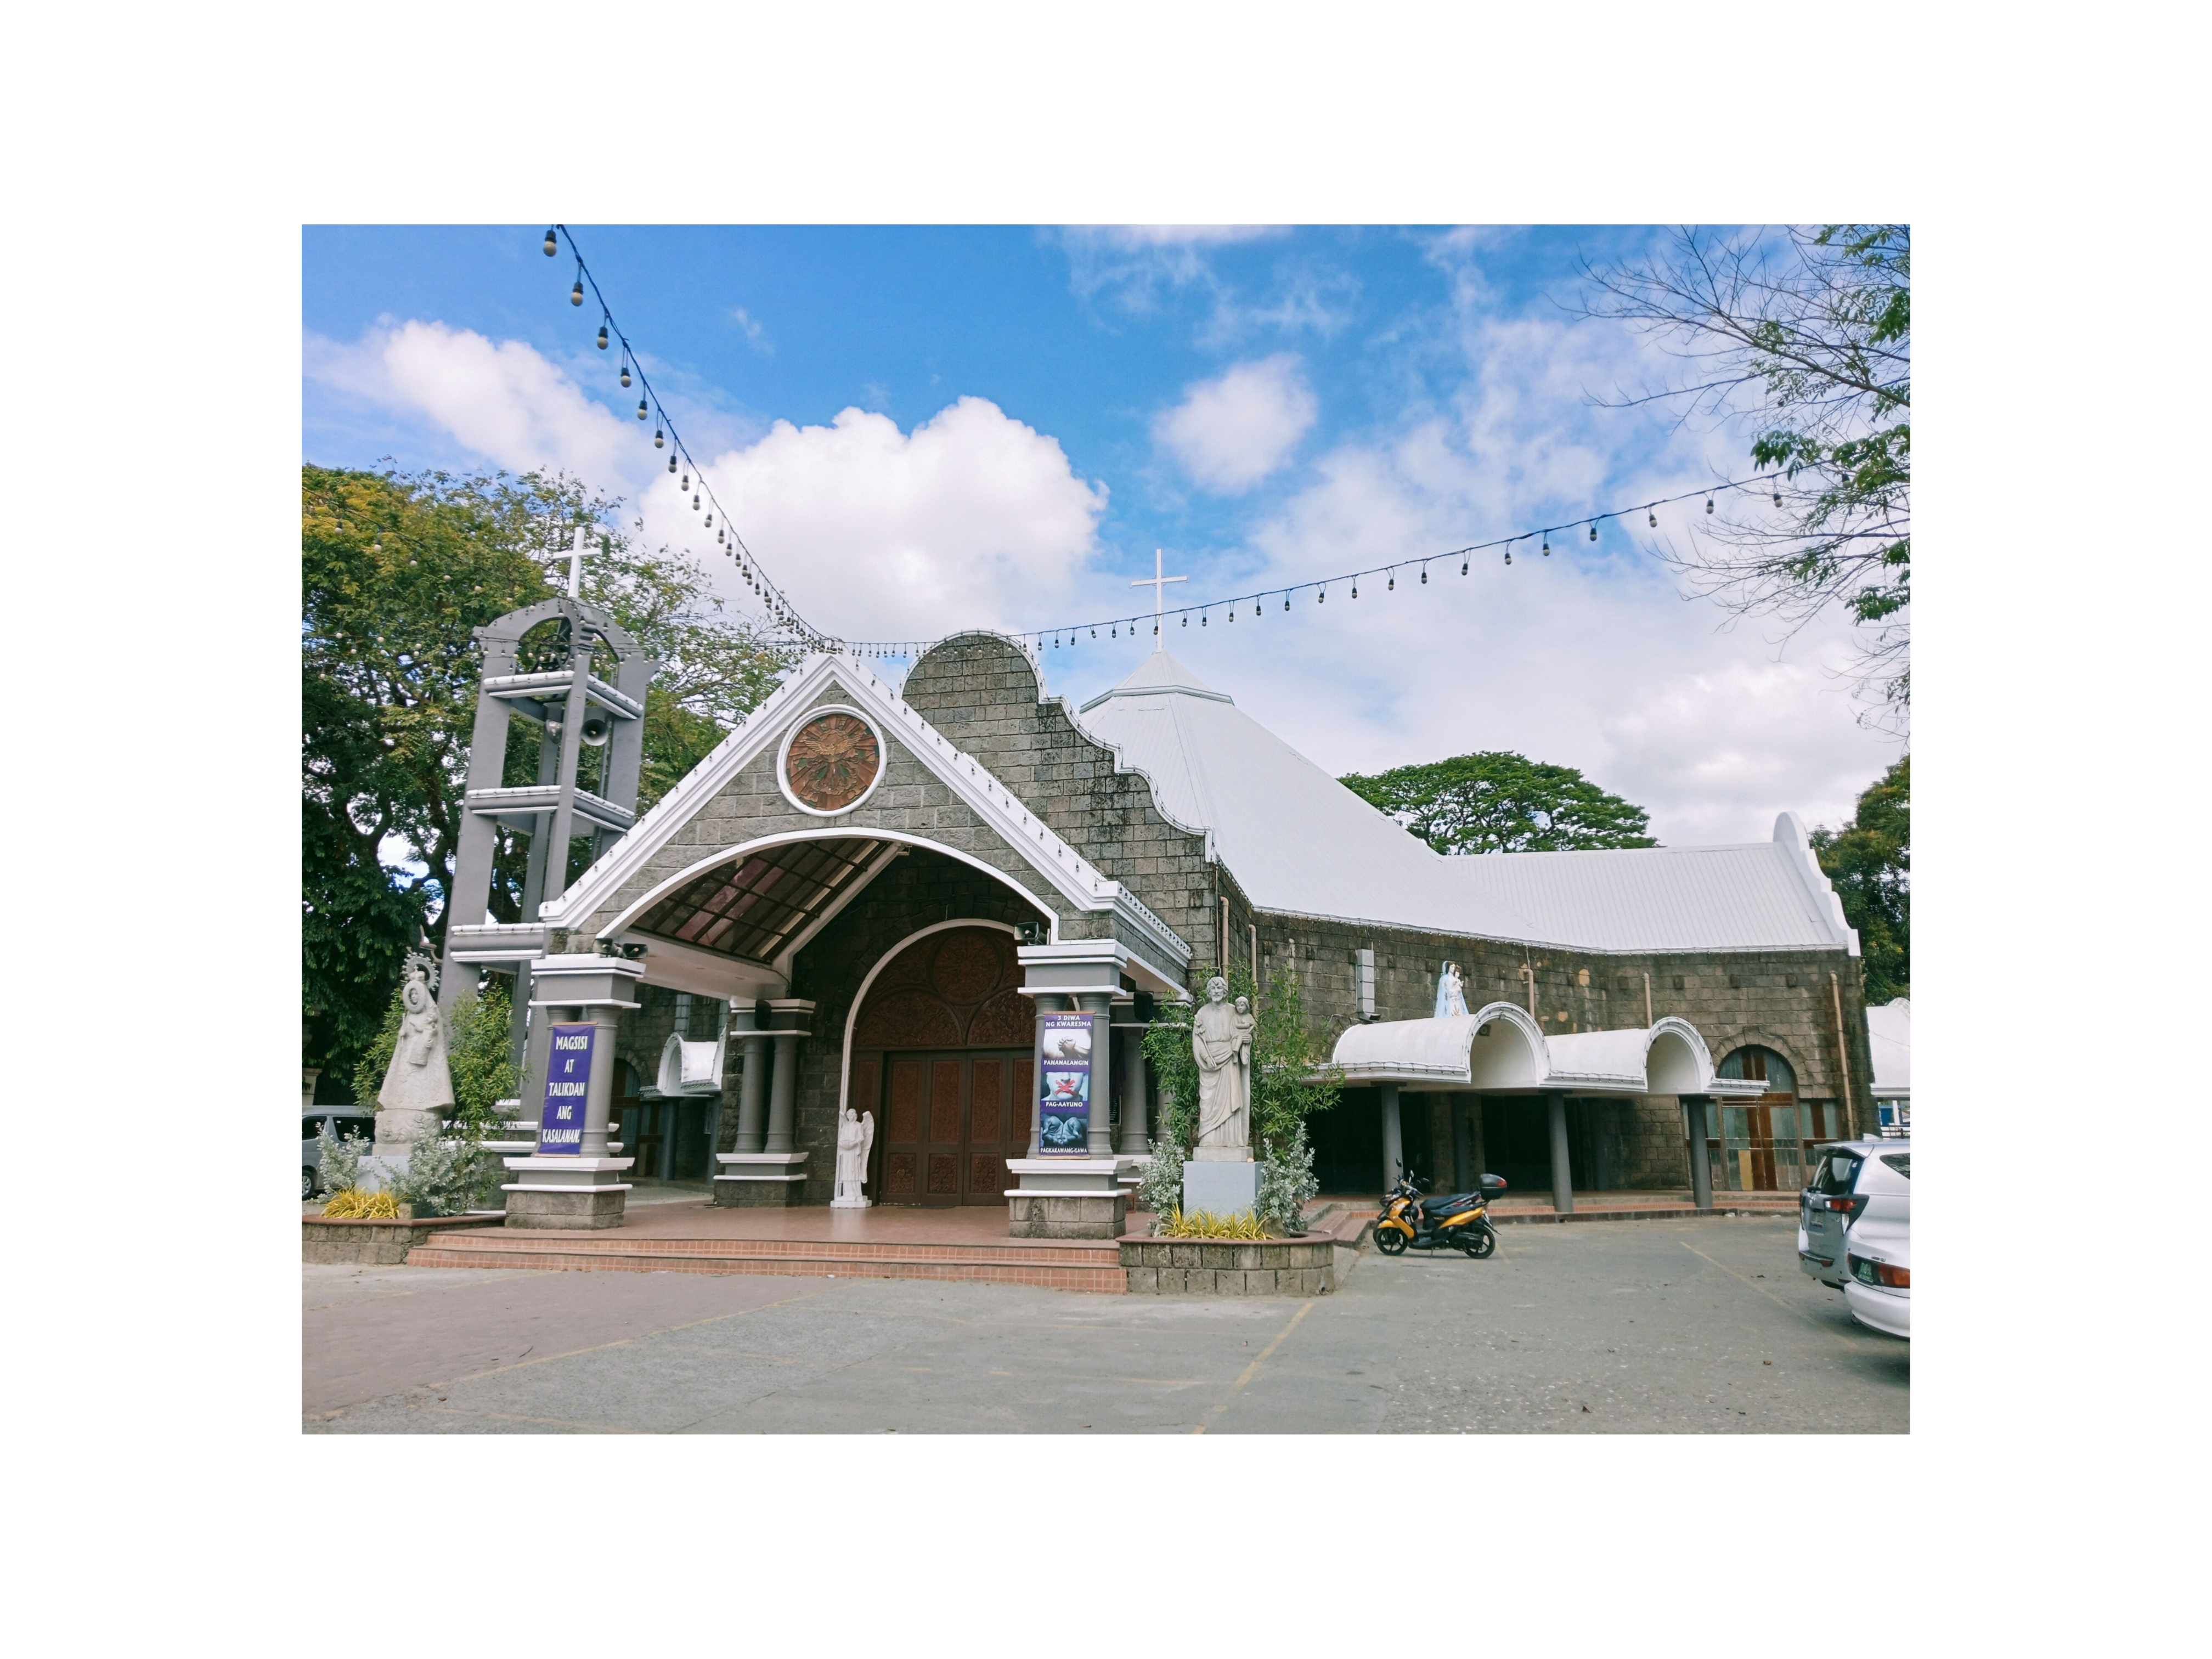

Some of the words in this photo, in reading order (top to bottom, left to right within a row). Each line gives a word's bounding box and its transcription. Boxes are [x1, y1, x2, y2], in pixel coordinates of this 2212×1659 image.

[555, 1036, 588, 1050] MAGSISI
[564, 1059, 574, 1073] AT
[549, 1082, 585, 1096] TALIKDAN
[556, 1105, 572, 1120] ANG
[542, 1129, 580, 1143] KASALANAN.
